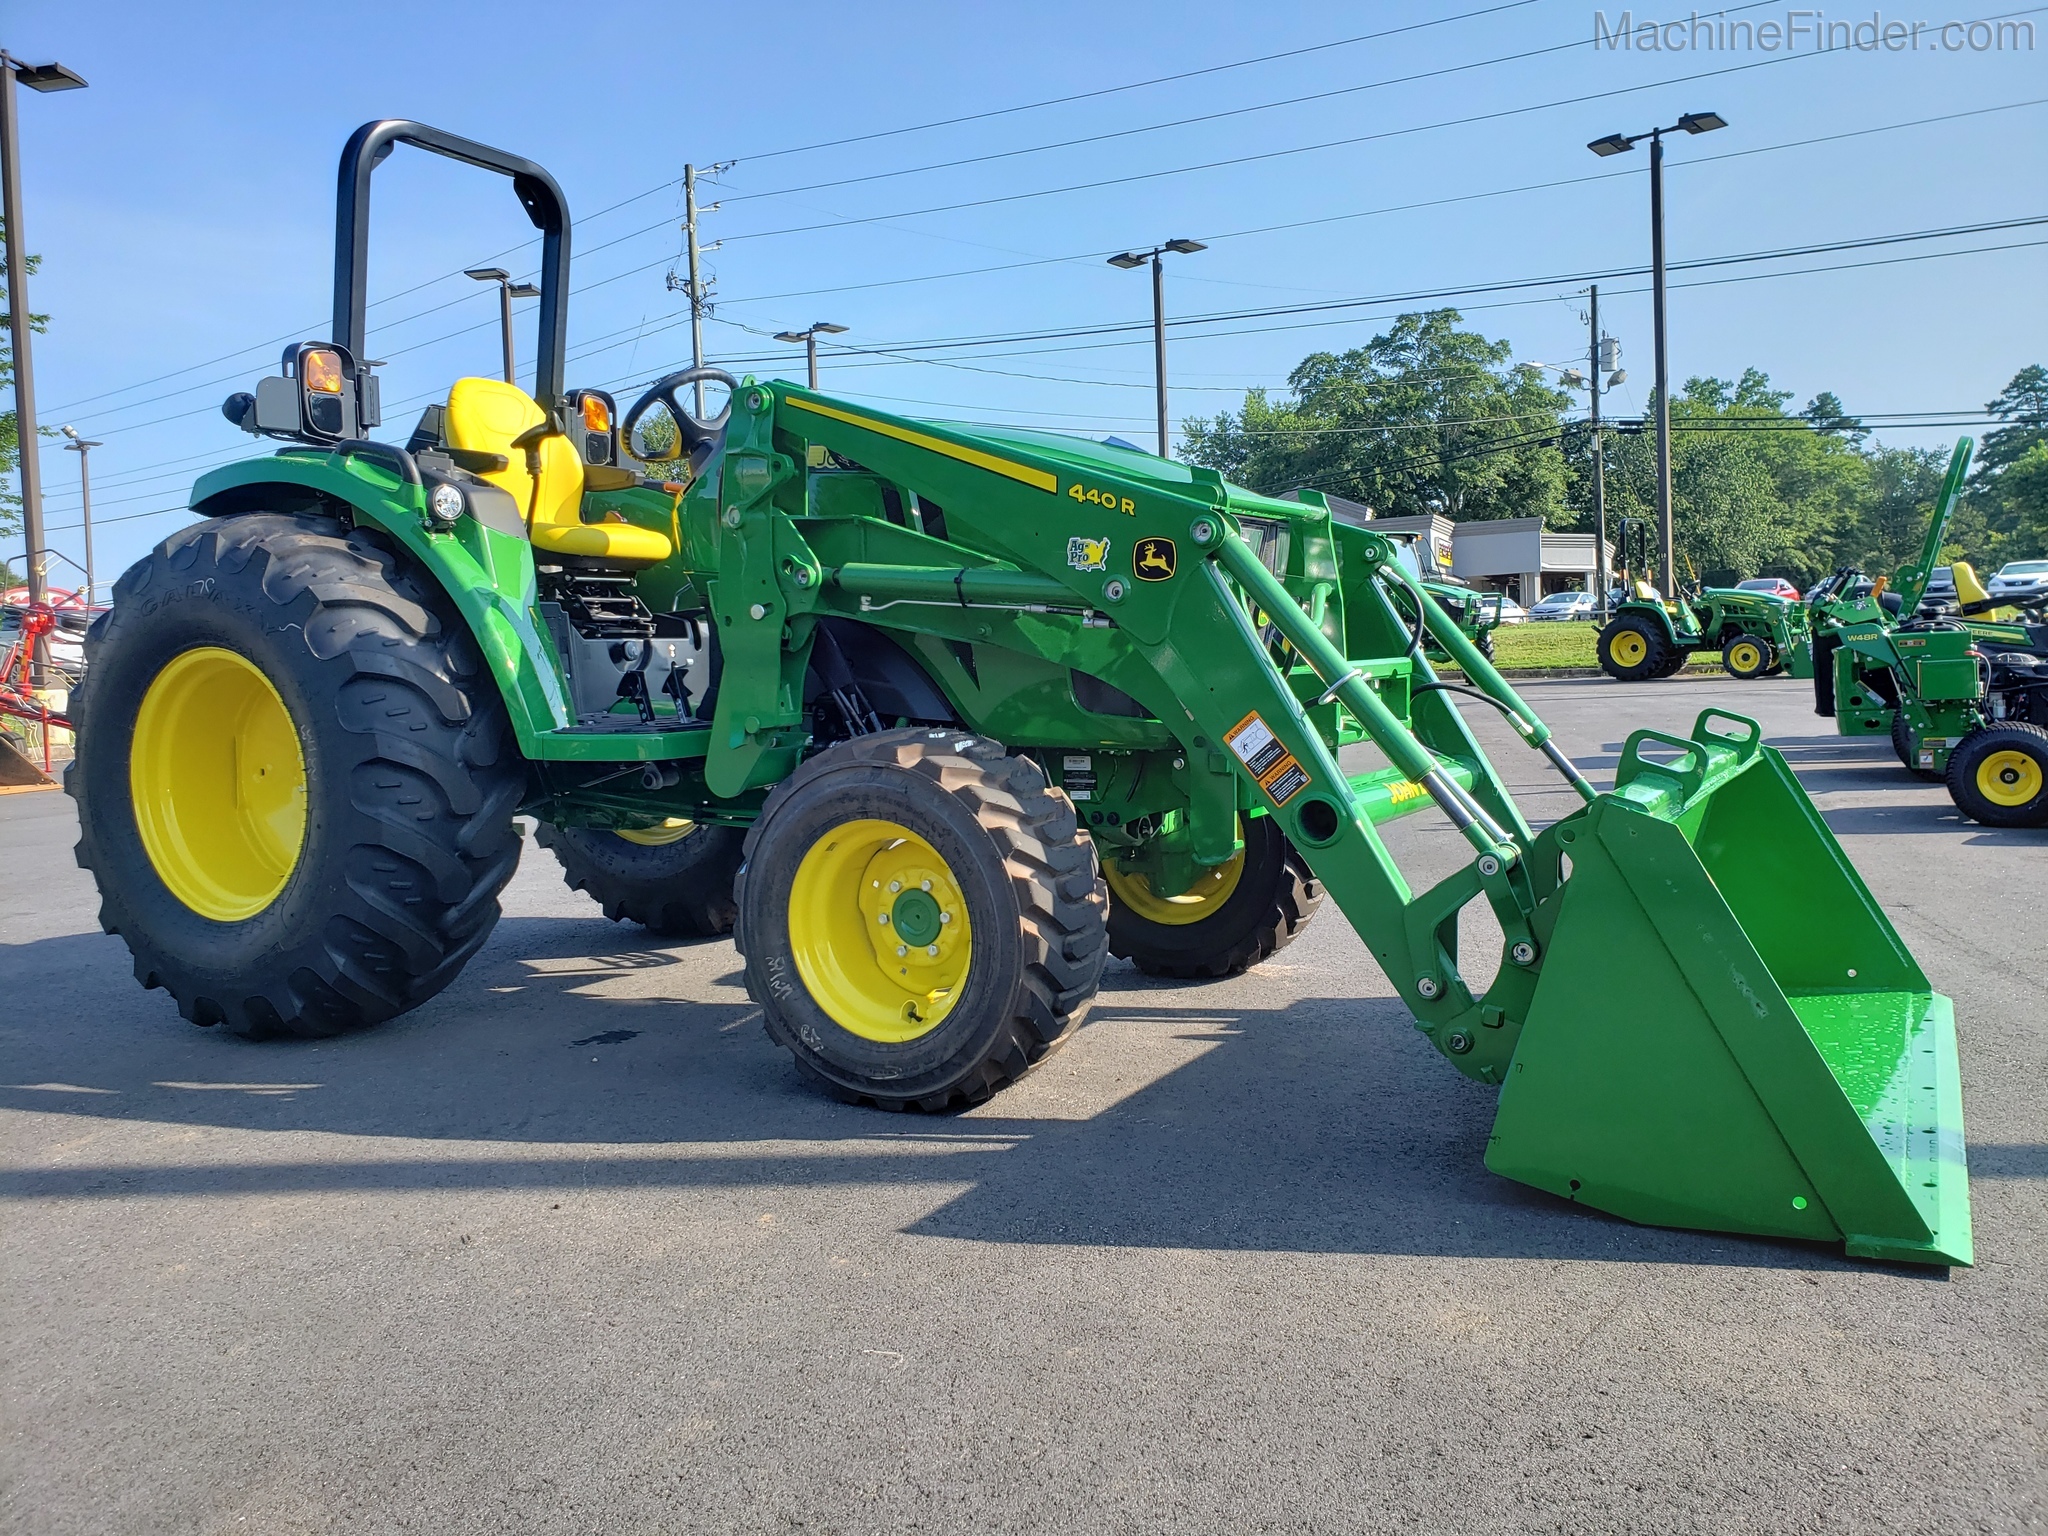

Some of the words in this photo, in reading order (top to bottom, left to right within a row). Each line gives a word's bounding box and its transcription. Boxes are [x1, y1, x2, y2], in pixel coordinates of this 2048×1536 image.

[1070, 540, 1090, 553] Ag-
[1070, 551, 1090, 563] Pro
[1847, 633, 1878, 642] W48R
[1972, 629, 1994, 637] EERE
[1233, 715, 1255, 736] WARNING
[1270, 760, 1292, 781] WARNING
